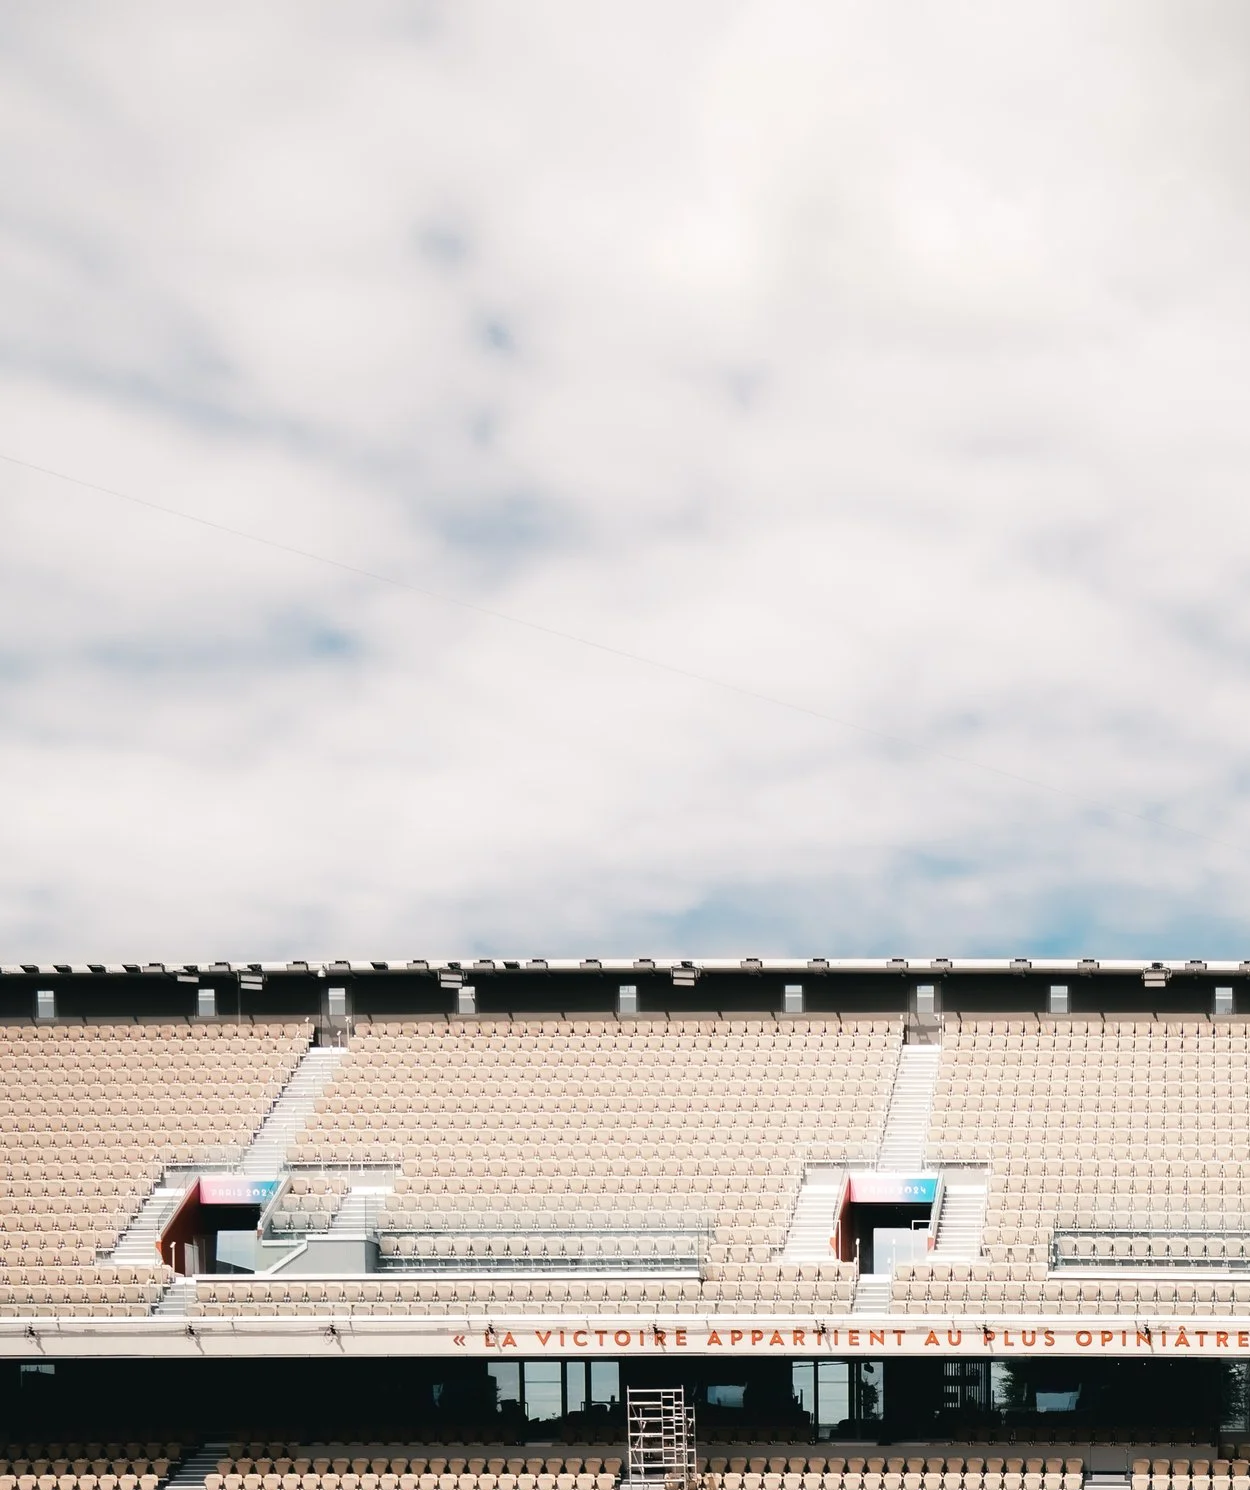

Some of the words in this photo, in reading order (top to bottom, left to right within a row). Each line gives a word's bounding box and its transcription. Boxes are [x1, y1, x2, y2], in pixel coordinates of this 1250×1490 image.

[484, 1330, 517, 1347] LA
[535, 1330, 687, 1347] VICTOIRE
[707, 1330, 905, 1346] APPARTIENT
[924, 1330, 962, 1346] AU
[984, 1330, 1055, 1347] PLUS
[1076, 1326, 1249, 1347] OPINIÂTRE
